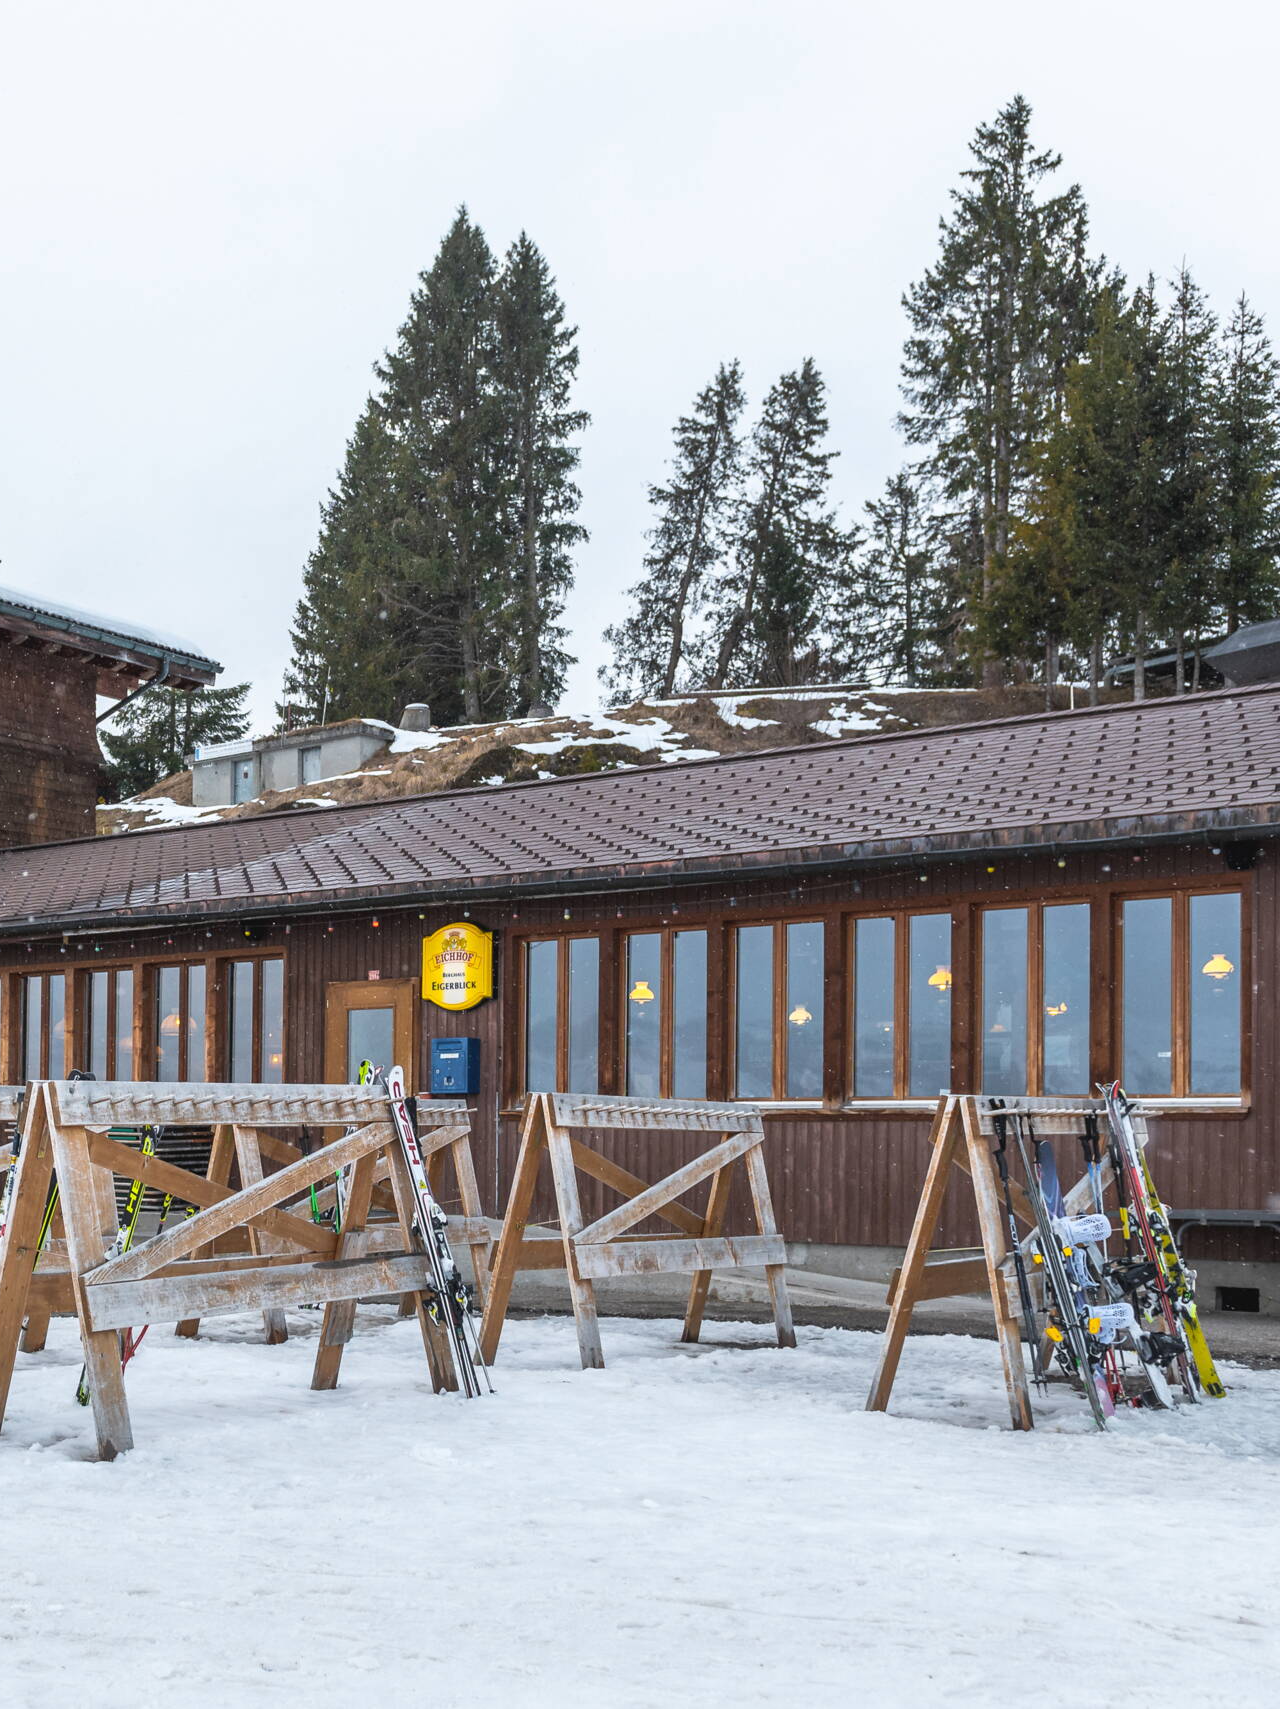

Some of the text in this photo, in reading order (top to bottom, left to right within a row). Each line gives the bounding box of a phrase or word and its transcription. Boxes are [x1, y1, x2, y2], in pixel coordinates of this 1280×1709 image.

[435, 951, 474, 965] EICHHOF
[431, 981, 477, 991] EIGERBLICK
[126, 1135, 155, 1213] HED
